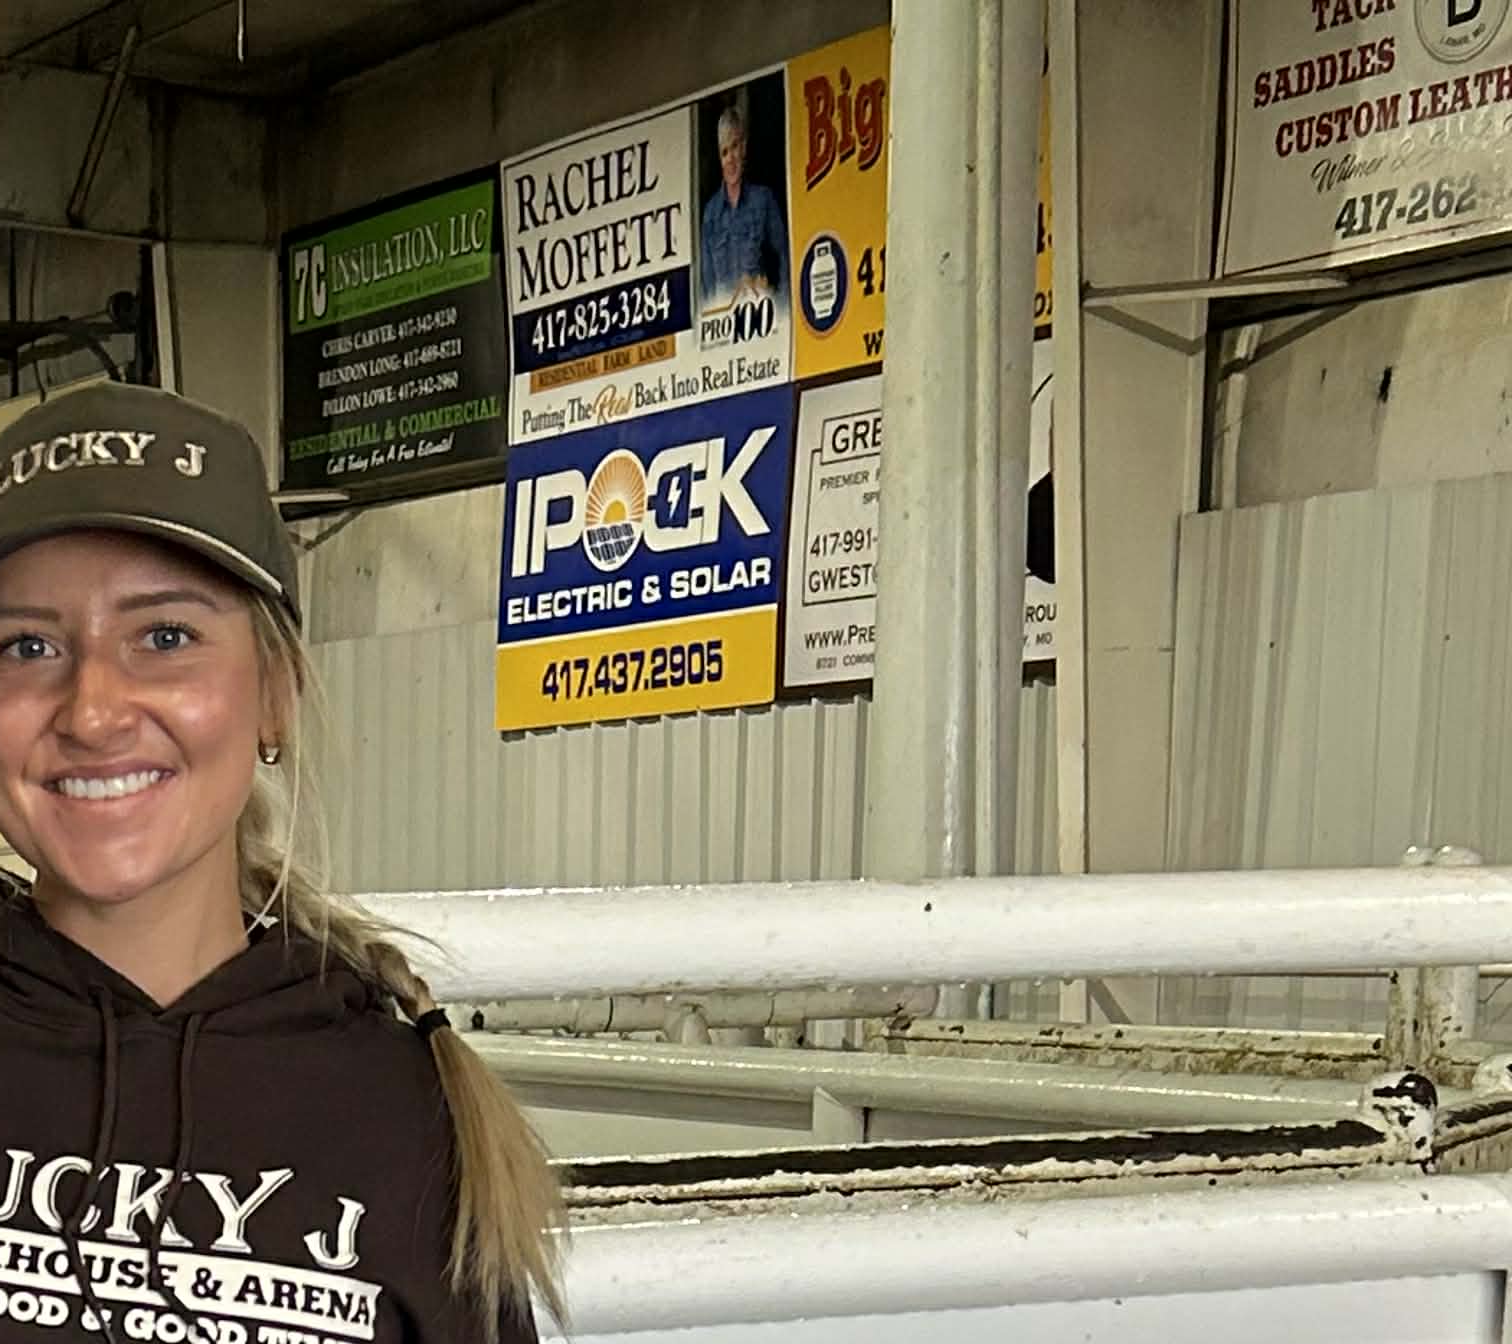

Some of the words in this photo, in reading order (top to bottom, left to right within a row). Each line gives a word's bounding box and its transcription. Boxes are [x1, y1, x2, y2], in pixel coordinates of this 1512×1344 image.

[1254, 37, 1395, 108] SADDLES
[804, 65, 885, 191] Big
[1276, 94, 1401, 158] CUSTOM
[515, 140, 659, 234] RACHEL
[449, 207, 486, 258] LLC
[517, 202, 681, 302] MOFFETT
[531, 280, 670, 353] 417-825-3284
[400, 396, 502, 438] COMMERCIAL
[521, 404, 566, 433] Putting
[568, 398, 593, 423] The
[634, 382, 667, 409] Back
[671, 373, 699, 400] Into
[701, 361, 734, 393] Real
[736, 355, 781, 385] Estate
[175, 442, 206, 477] J
[820, 470, 870, 491] PREMIER
[507, 580, 633, 625] ELECTRIC
[641, 575, 662, 604] &
[670, 557, 771, 600] SOLAR
[542, 640, 723, 701] 417.437.2905
[304, 1197, 366, 1269] J
[191, 1267, 222, 1302] &
[233, 1275, 371, 1327] ARENA
